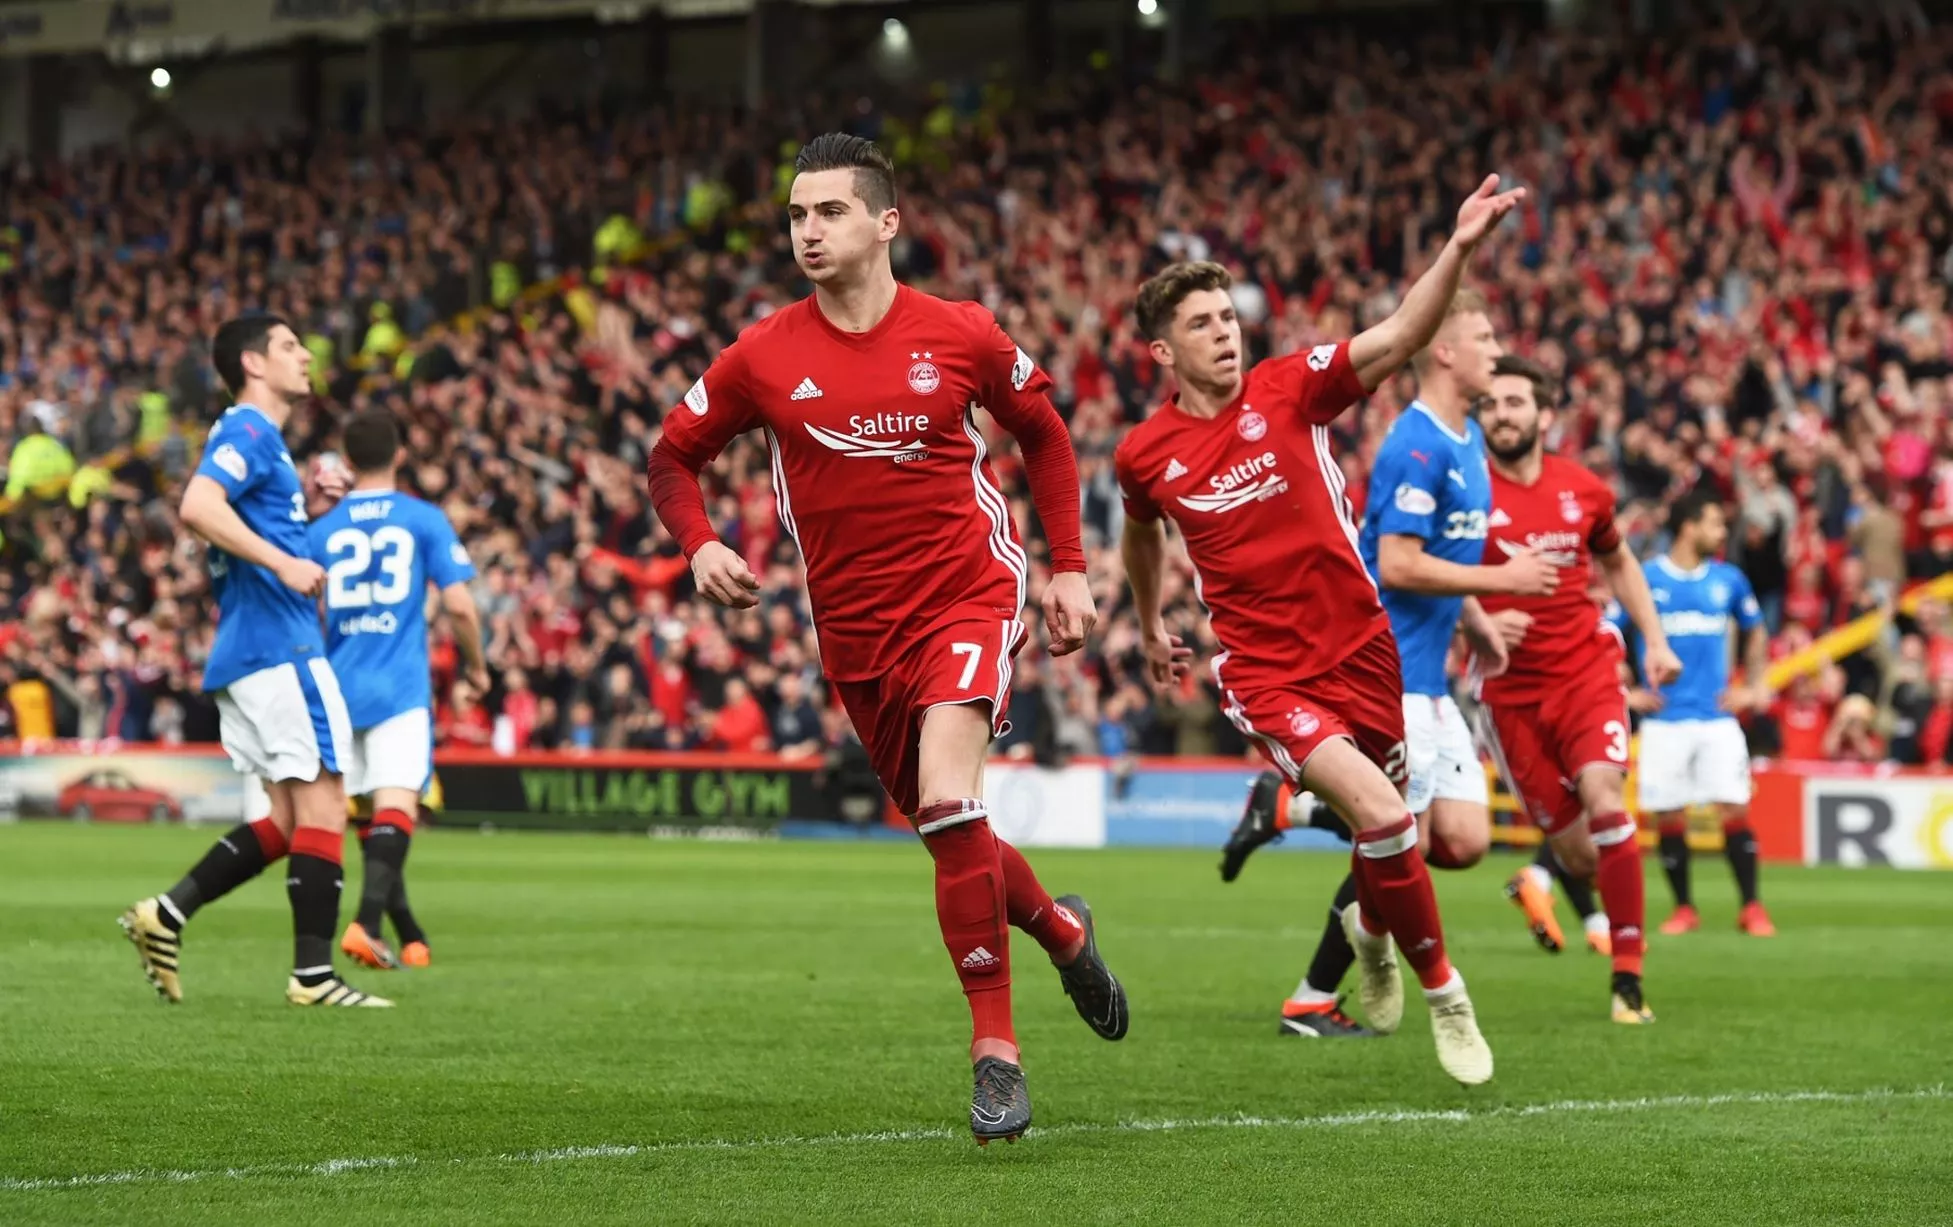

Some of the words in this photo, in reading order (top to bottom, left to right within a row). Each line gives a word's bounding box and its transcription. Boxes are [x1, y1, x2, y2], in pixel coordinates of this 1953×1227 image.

[790, 389, 823, 400] adidas
[849, 411, 929, 437] Saltire
[893, 450, 930, 463] energy
[1209, 451, 1277, 495] Saltire
[326, 525, 416, 610] 23
[951, 642, 983, 691] 7
[1602, 720, 1628, 762] 3
[520, 769, 680, 816] VILLAGE
[692, 769, 790, 816] GYM
